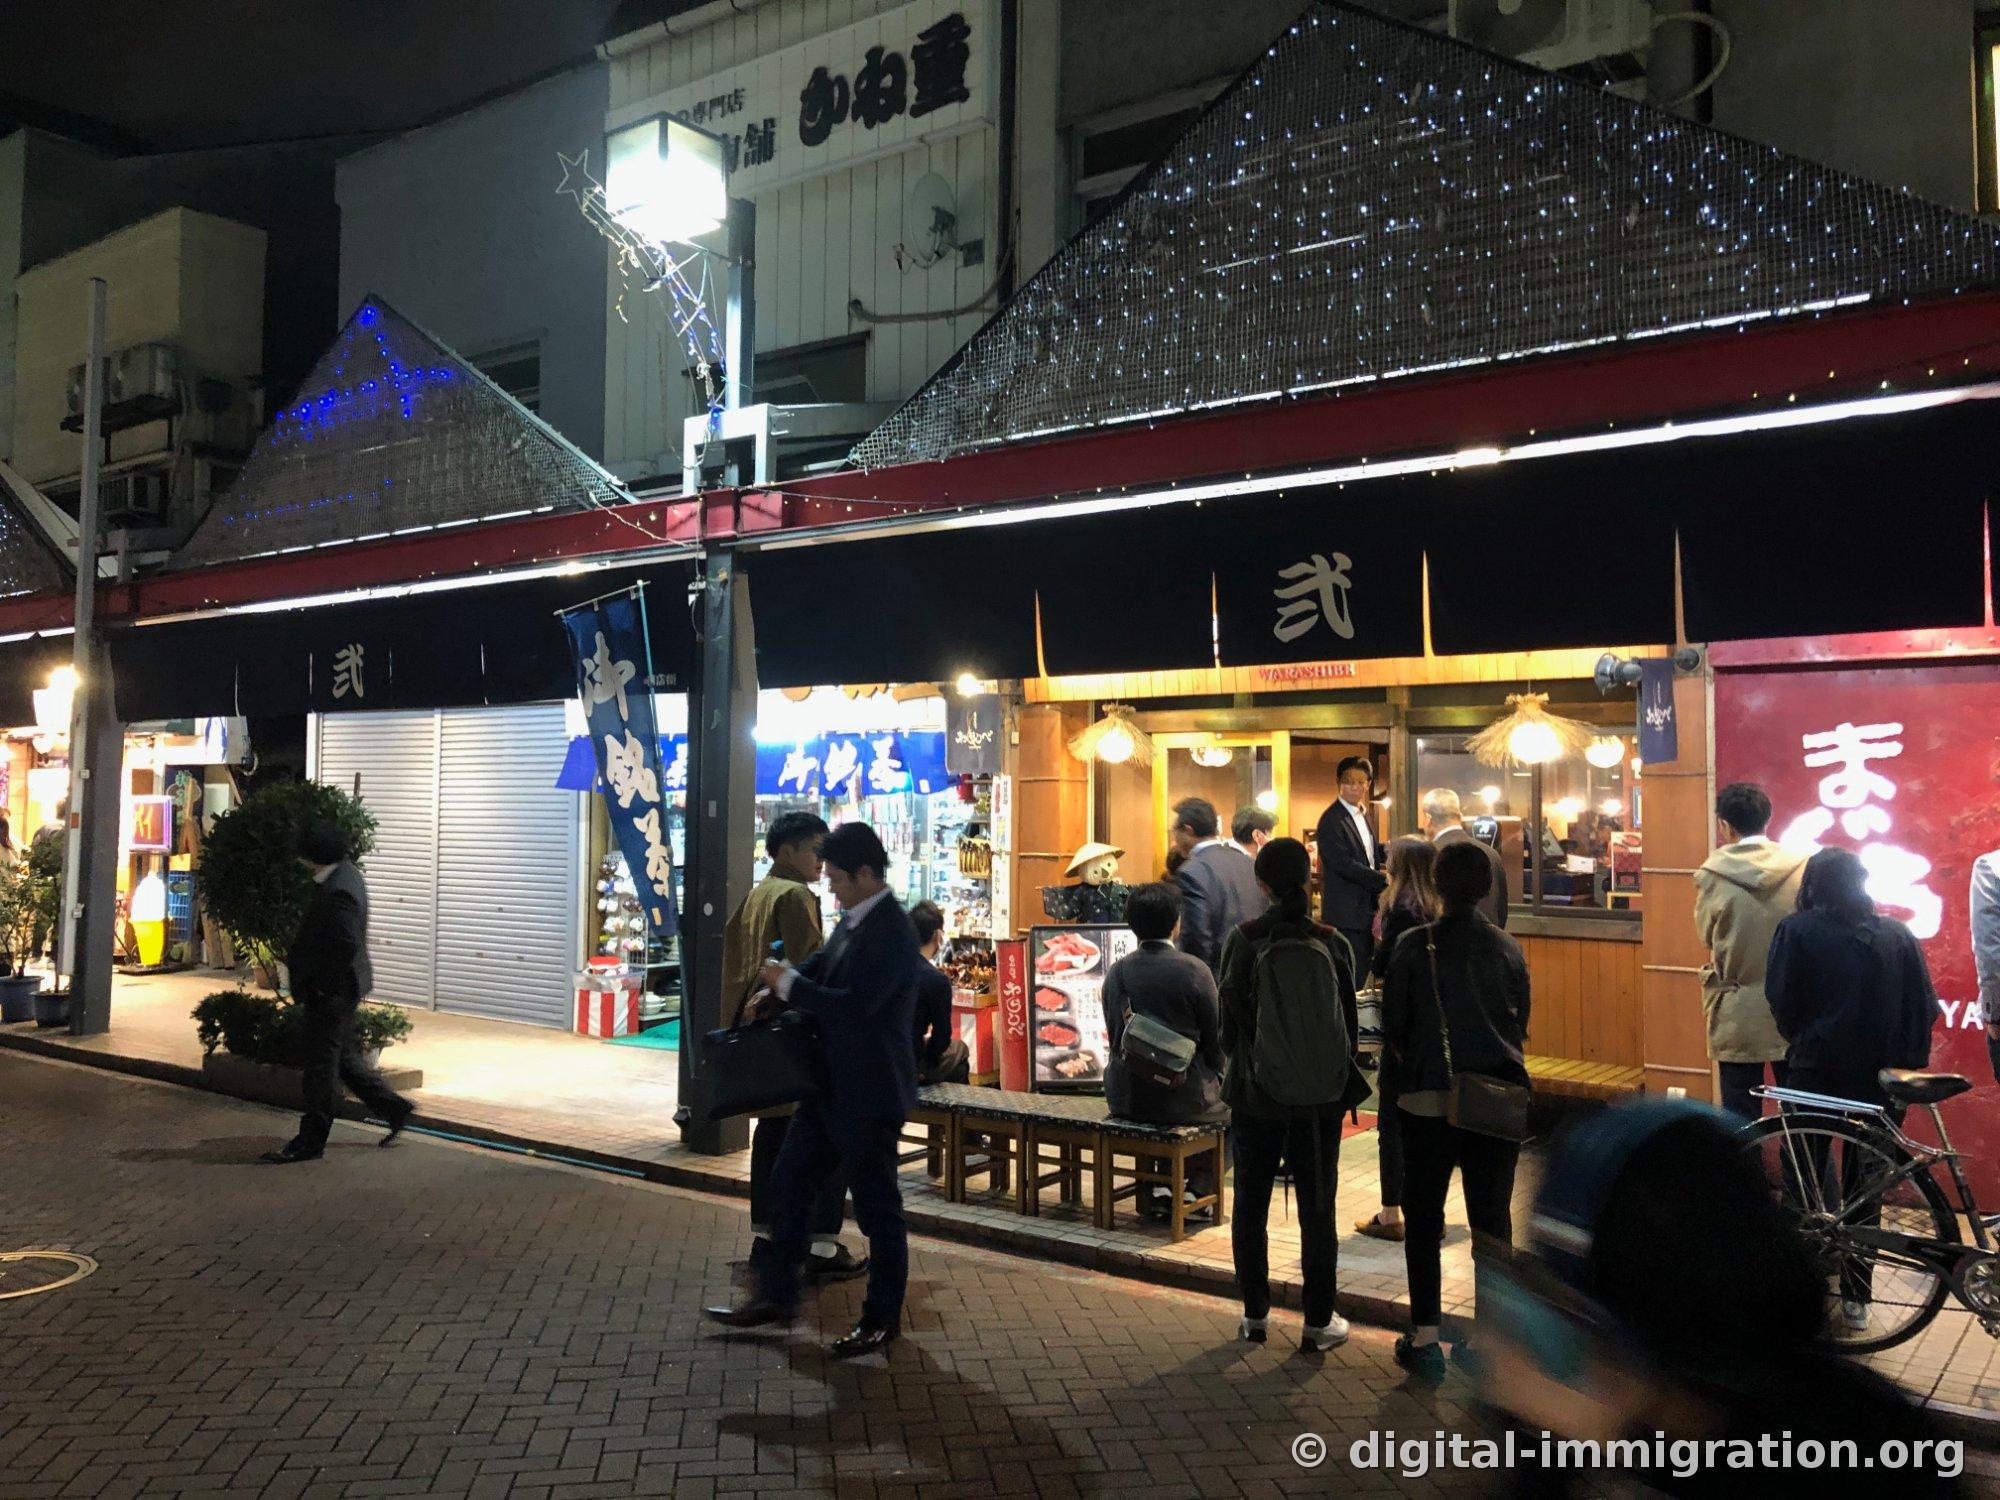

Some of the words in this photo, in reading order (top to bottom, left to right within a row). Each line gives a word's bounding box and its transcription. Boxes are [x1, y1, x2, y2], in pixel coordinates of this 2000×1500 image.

[799, 12, 971, 146] かね重
[1273, 552, 1354, 643] 弐
[332, 643, 364, 699] 弐
